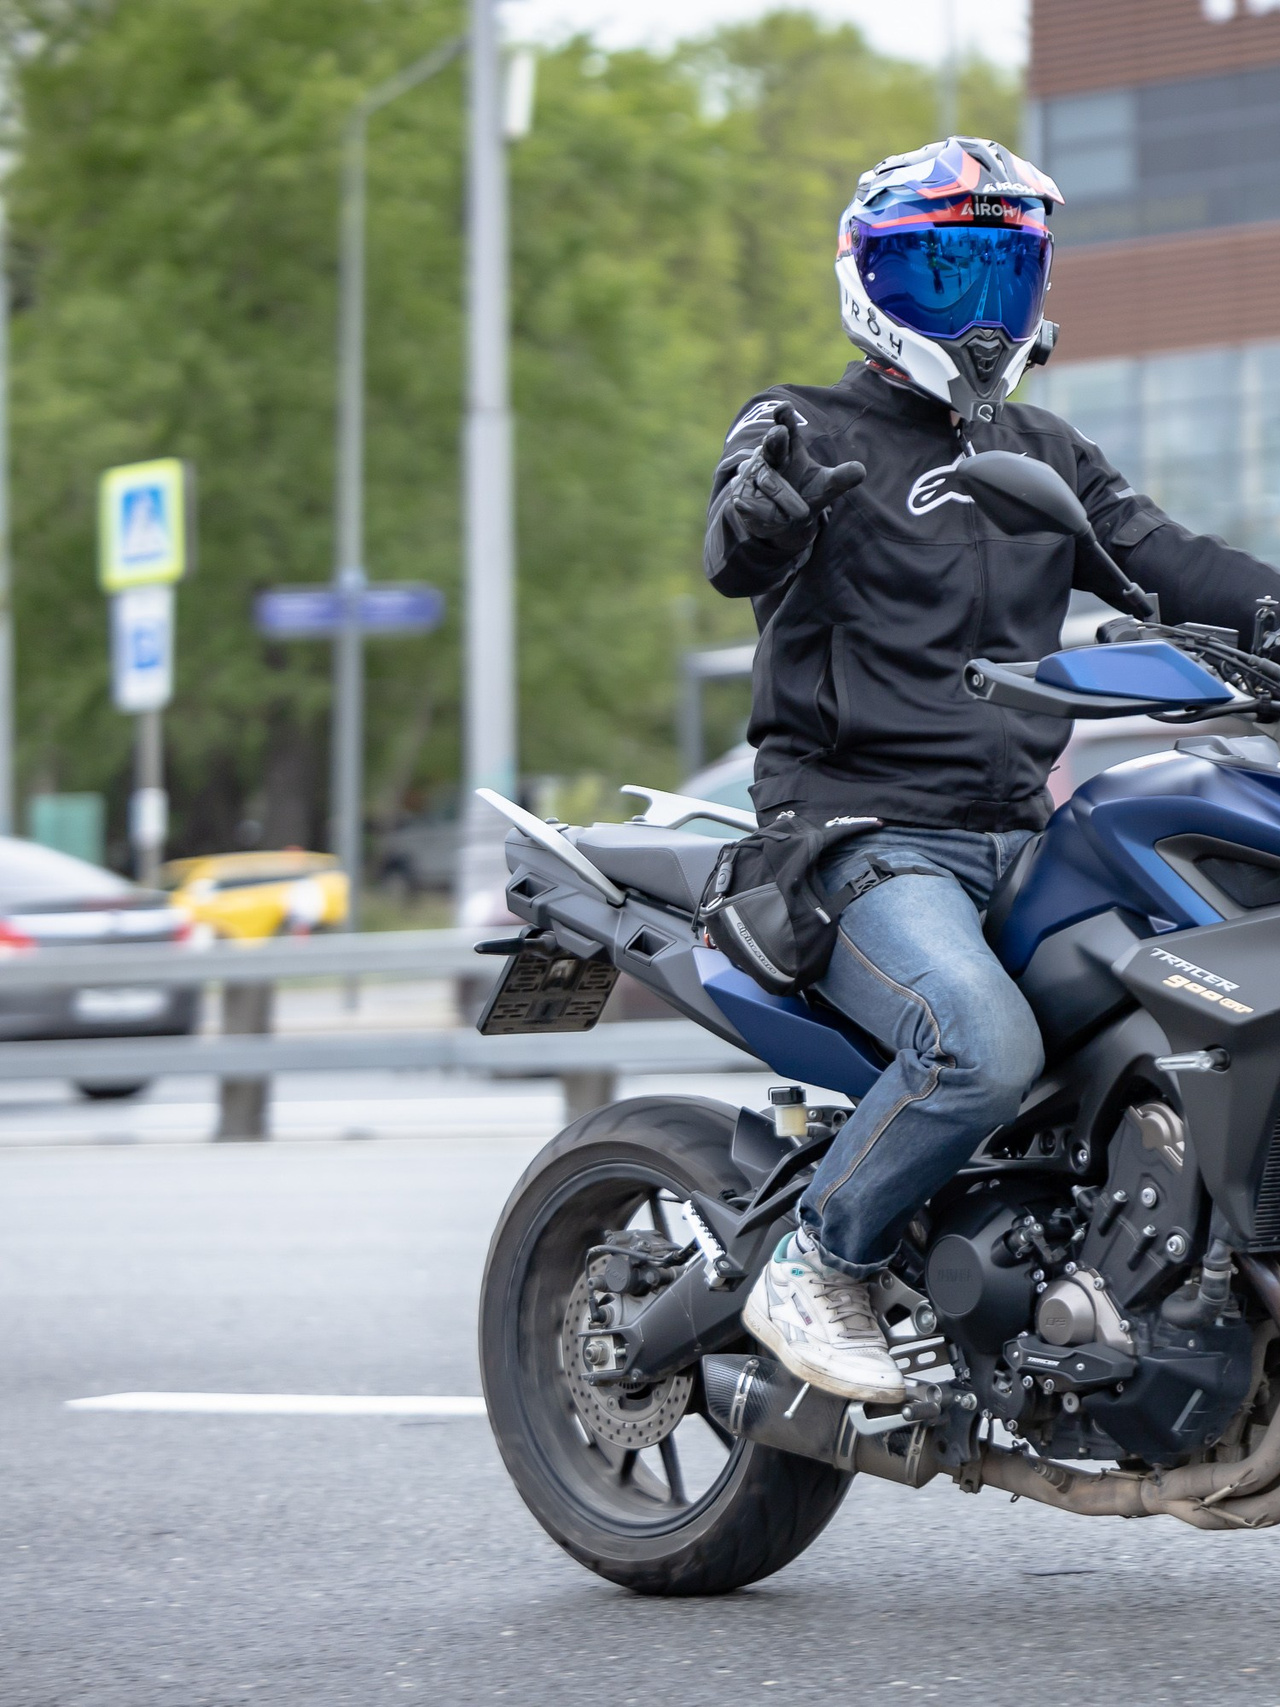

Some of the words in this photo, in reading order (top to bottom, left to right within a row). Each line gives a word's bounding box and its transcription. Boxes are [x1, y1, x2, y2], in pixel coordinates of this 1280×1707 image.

[982, 181, 1037, 195] AIROH
[961, 202, 1014, 217] AIROH
[844, 288, 903, 356] IROH
[1150, 948, 1240, 992] TRACER
